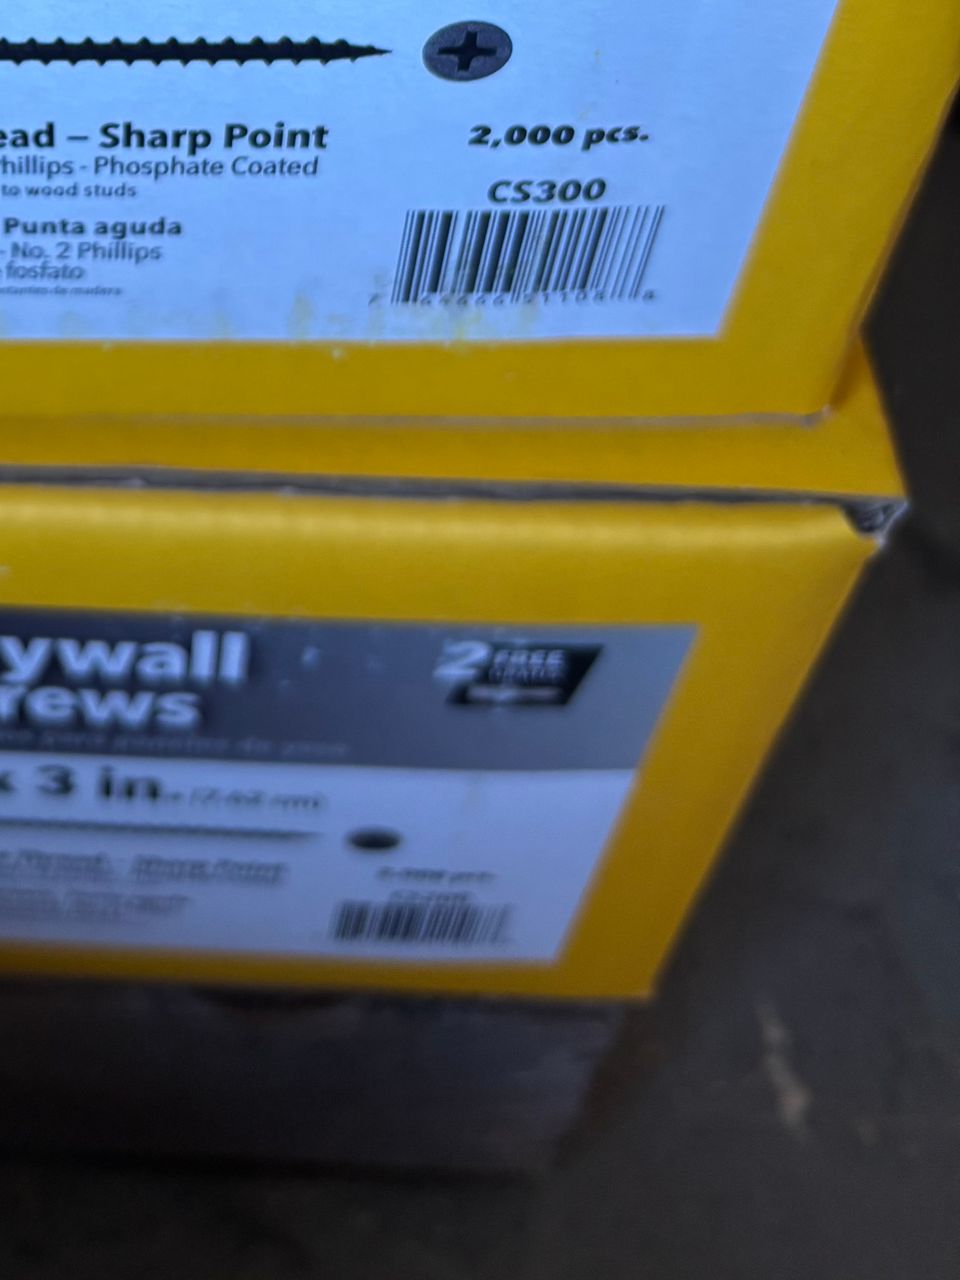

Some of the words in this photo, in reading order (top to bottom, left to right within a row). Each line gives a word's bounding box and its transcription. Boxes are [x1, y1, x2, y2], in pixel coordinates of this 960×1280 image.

[99, 121, 212, 156] Sharp
[224, 121, 328, 148] Point
[467, 124, 575, 149] 2,000
[580, 125, 650, 151] pcs.
[94, 155, 224, 180] Phosphate
[231, 155, 319, 176] Coated
[1, 183, 19, 198] to
[25, 182, 78, 198] wood
[83, 182, 137, 198] studs
[487, 178, 607, 204] CS300
[4, 218, 85, 236] Punta
[94, 217, 182, 240] aguda
[56, 242, 71, 260] 2
[77, 241, 163, 264] Phillips
[5, 259, 86, 280] fosfato
[434, 640, 490, 680] 2
[36, 763, 75, 797] 3
